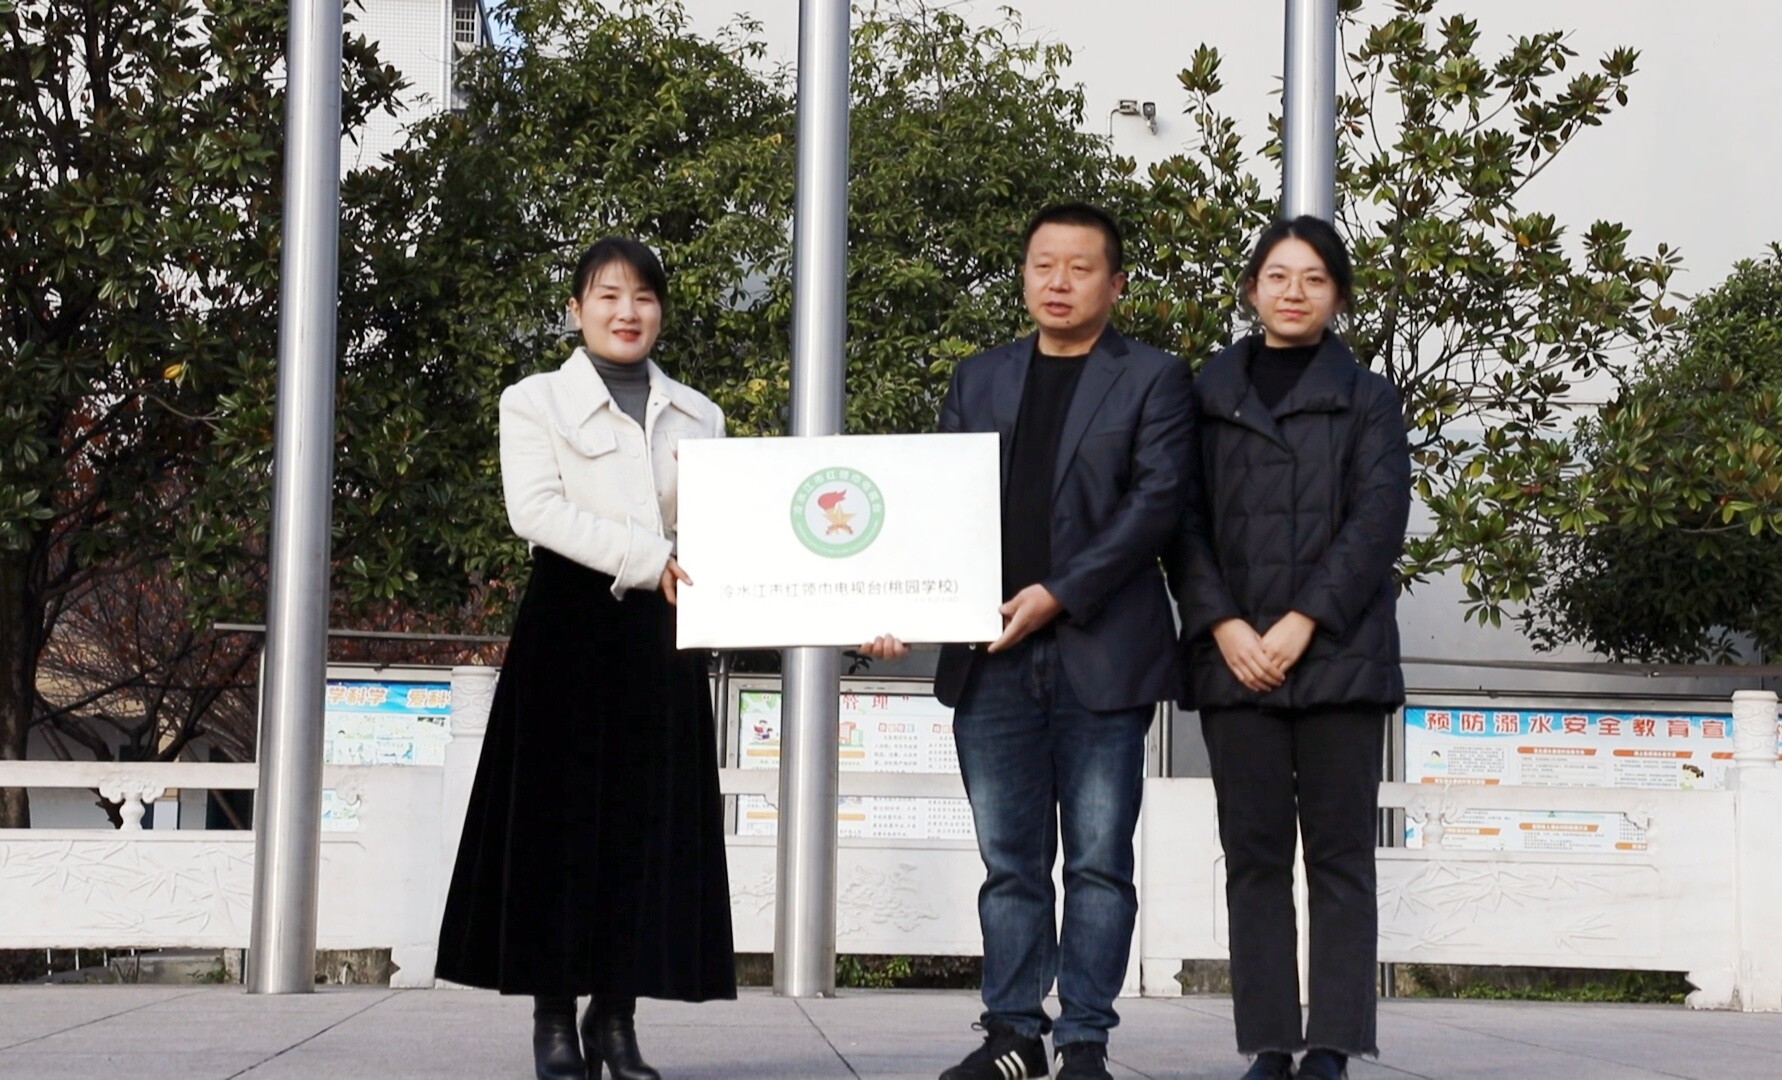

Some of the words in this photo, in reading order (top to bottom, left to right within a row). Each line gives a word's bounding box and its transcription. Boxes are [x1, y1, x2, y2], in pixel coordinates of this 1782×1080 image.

[720, 579, 959, 599] 冷水江市红领巾电视台(桃园学校)
